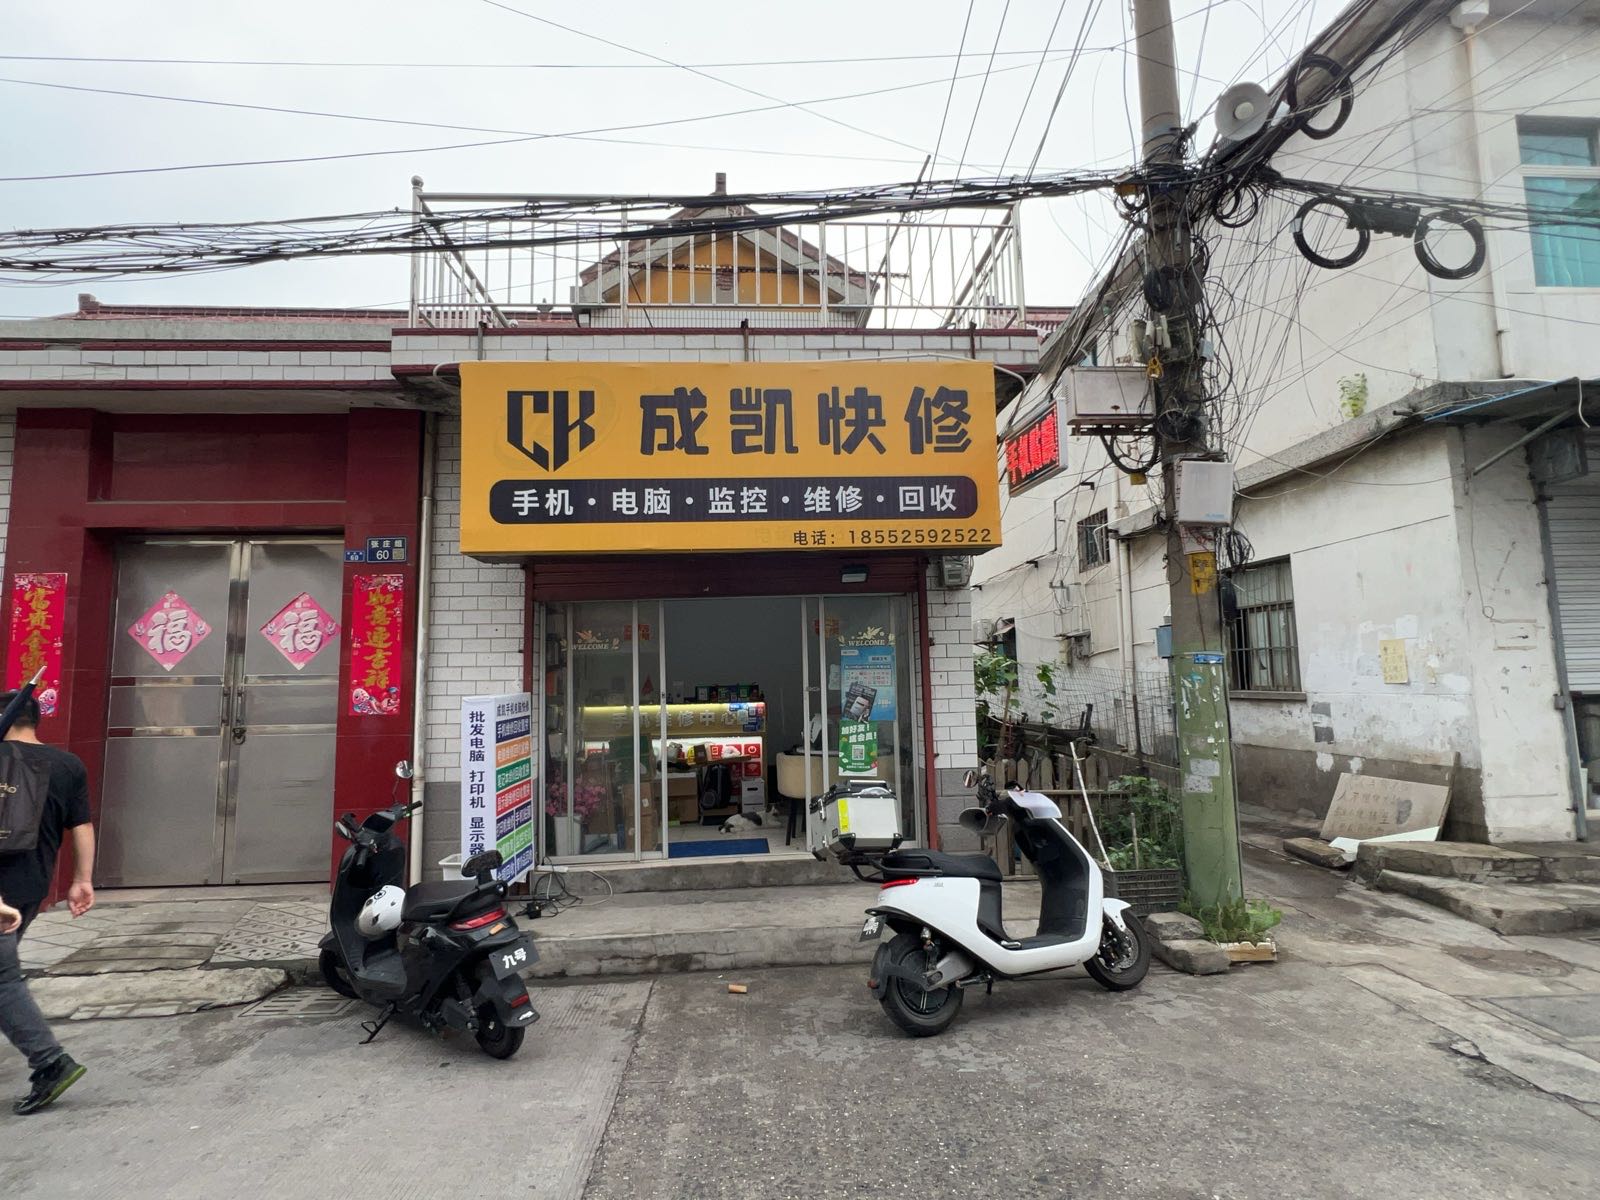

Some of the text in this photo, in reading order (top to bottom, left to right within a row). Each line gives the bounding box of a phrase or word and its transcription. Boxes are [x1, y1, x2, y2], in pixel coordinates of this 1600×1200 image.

[640, 386, 972, 455] 成凯快修
[376, 550, 389, 560] 60
[147, 609, 192, 654] 福
[279, 609, 323, 654] 福
[469, 711, 486, 856] 批发电脑 打印机 显示器
[502, 947, 527, 969] 九号
